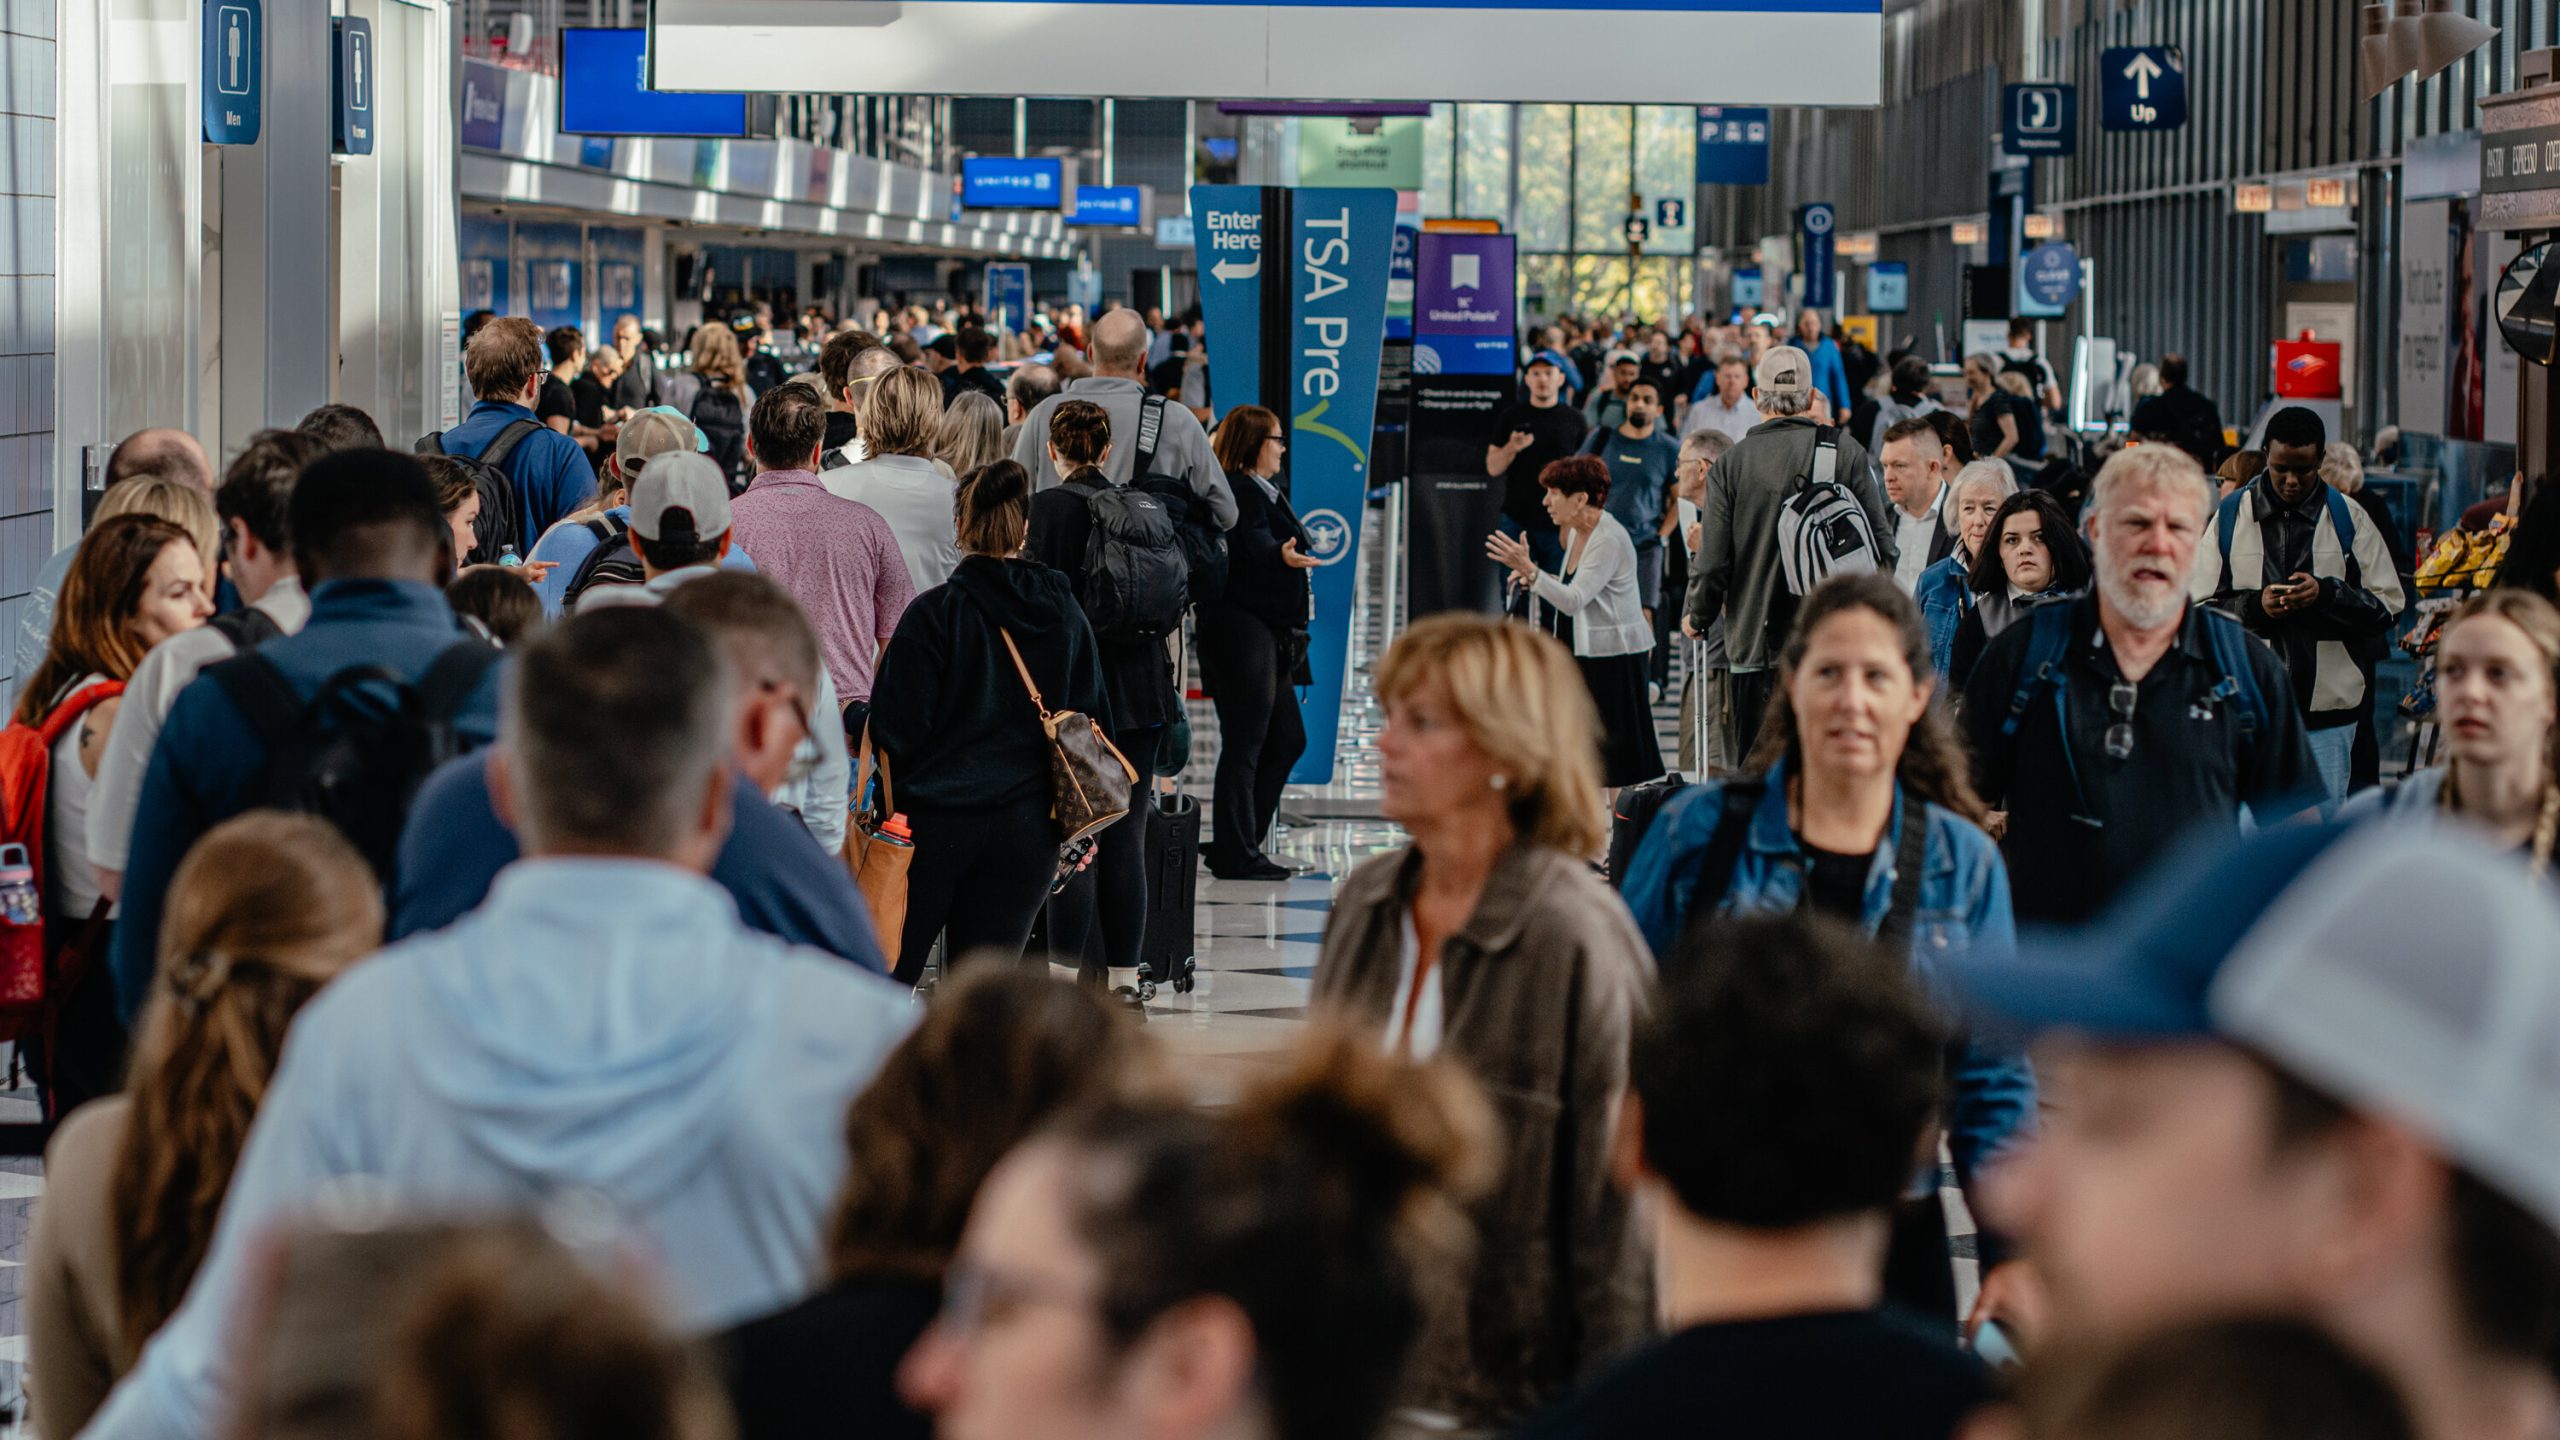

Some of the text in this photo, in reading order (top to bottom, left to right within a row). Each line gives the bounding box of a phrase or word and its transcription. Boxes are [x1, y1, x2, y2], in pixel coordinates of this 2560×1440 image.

[226, 110, 241, 126] Men
[2130, 103, 2158, 124] Up
[2487, 147, 2506, 178] PASTRY
[2512, 142, 2538, 176] ESPRESSO
[2238, 187, 2270, 208] EXIT
[2308, 180, 2341, 203] EXIT
[1206, 211, 1262, 230] Enter
[1213, 231, 1262, 250] Here
[1302, 207, 1350, 397] TSA Pre
[1429, 310, 1461, 322] United
[1475, 342, 1509, 350] UNITED
